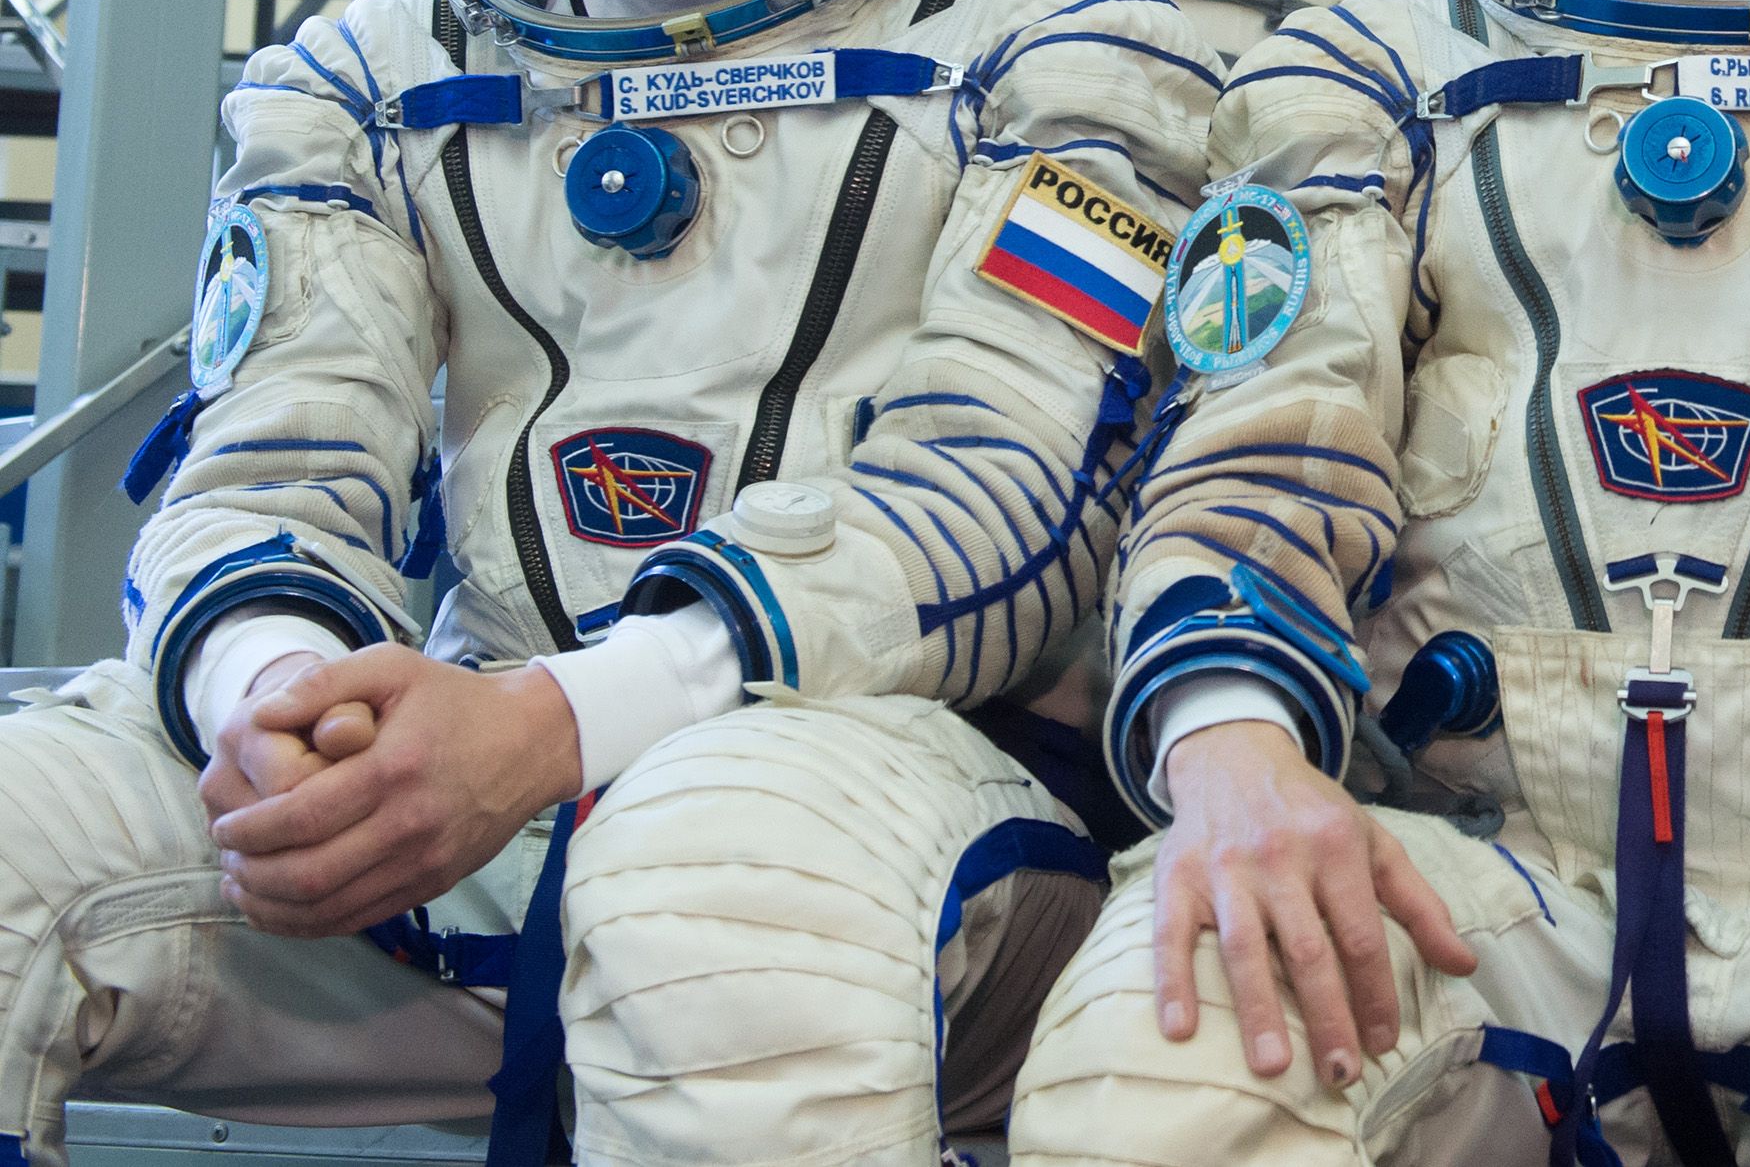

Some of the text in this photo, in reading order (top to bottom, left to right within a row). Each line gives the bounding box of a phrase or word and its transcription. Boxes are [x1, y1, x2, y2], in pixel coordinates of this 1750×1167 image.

[647, 61, 825, 92] КУДЬ-СВЕРЧКОВ
[620, 80, 825, 114] S. KUD-SVERCHKOV
[1711, 87, 1727, 106] S.
[1029, 165, 1173, 268] РОССИЯ
